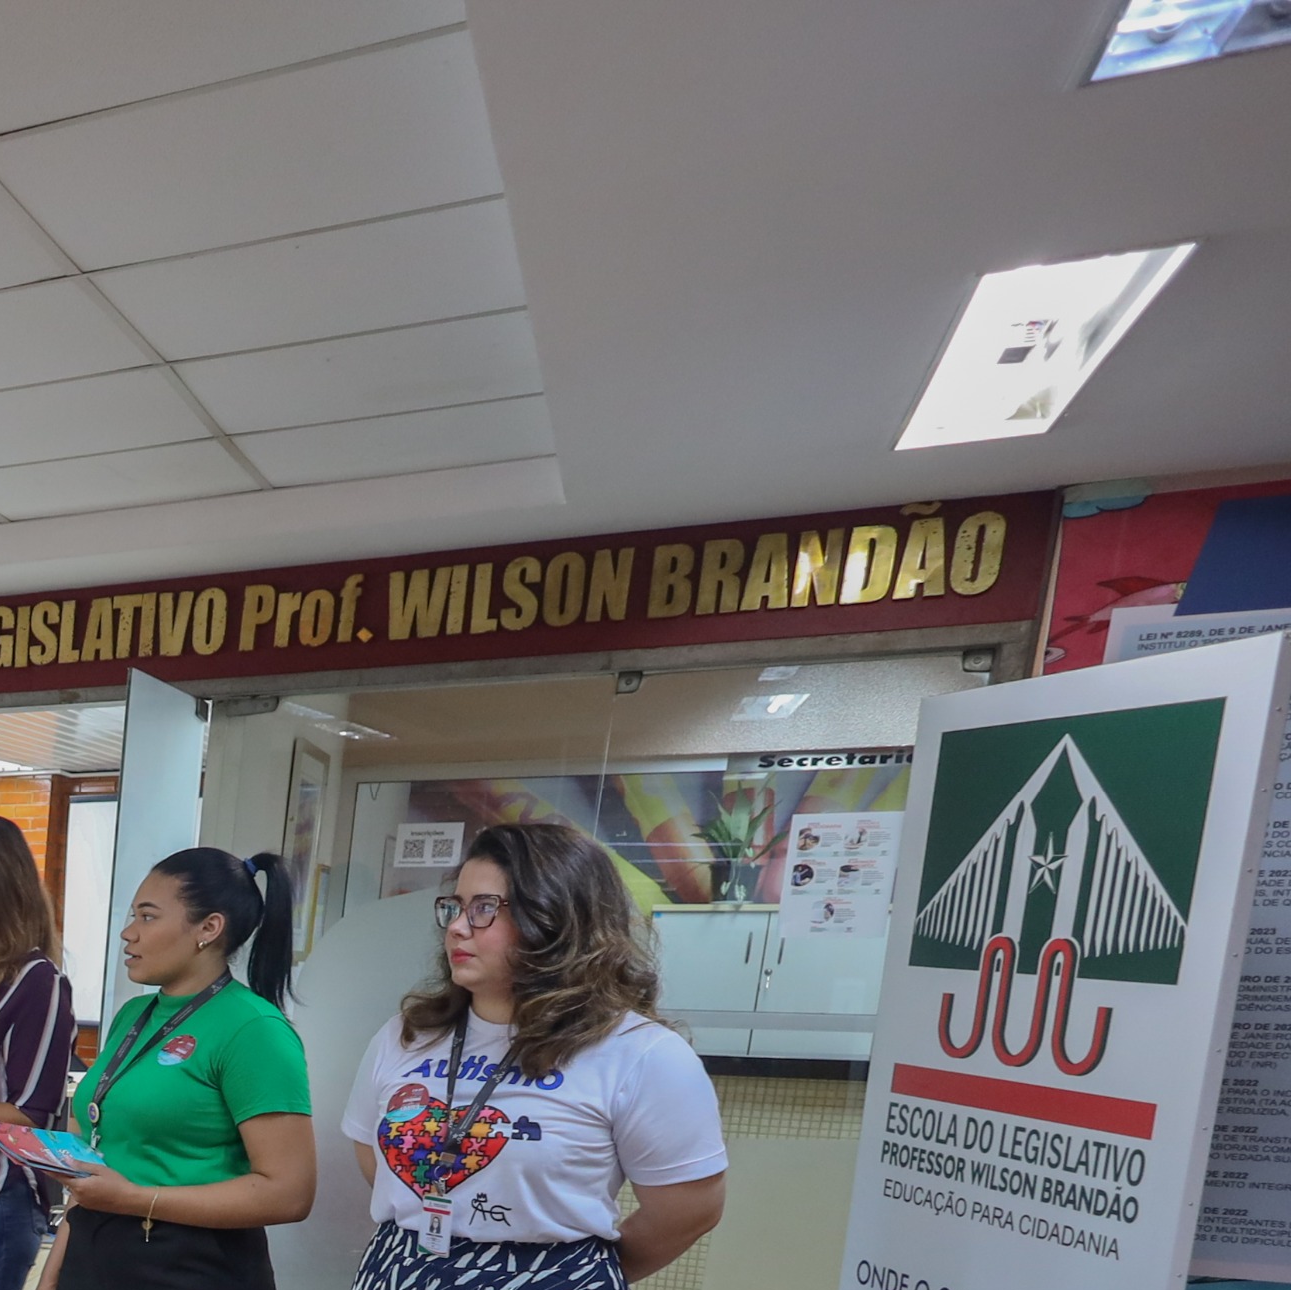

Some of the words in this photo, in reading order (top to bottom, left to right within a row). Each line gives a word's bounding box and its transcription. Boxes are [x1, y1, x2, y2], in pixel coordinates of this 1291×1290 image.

[238, 573, 375, 653] Prof.
[387, 547, 636, 641] WILSON
[647, 501, 1008, 620] BRANDÃO
[1139, 633, 1157, 641] LEI
[1209, 628, 1225, 637] DE
[1228, 627, 1236, 636] 9
[1238, 625, 1256, 635] DE
[880, 1140, 966, 1183] PROFESSOR
[970, 1159, 1039, 1200] WILSON
[1040, 1176, 1140, 1224] BRANDÃO
[885, 1101, 959, 1148] ESCOLA
[963, 1116, 995, 1154] DO
[998, 1123, 1147, 1187] LEGISLATIVO
[882, 1178, 968, 1218] EDUCAÇÃO
[970, 1201, 1015, 1232] PARA
[1019, 1213, 1121, 1261] CIDADANIA
